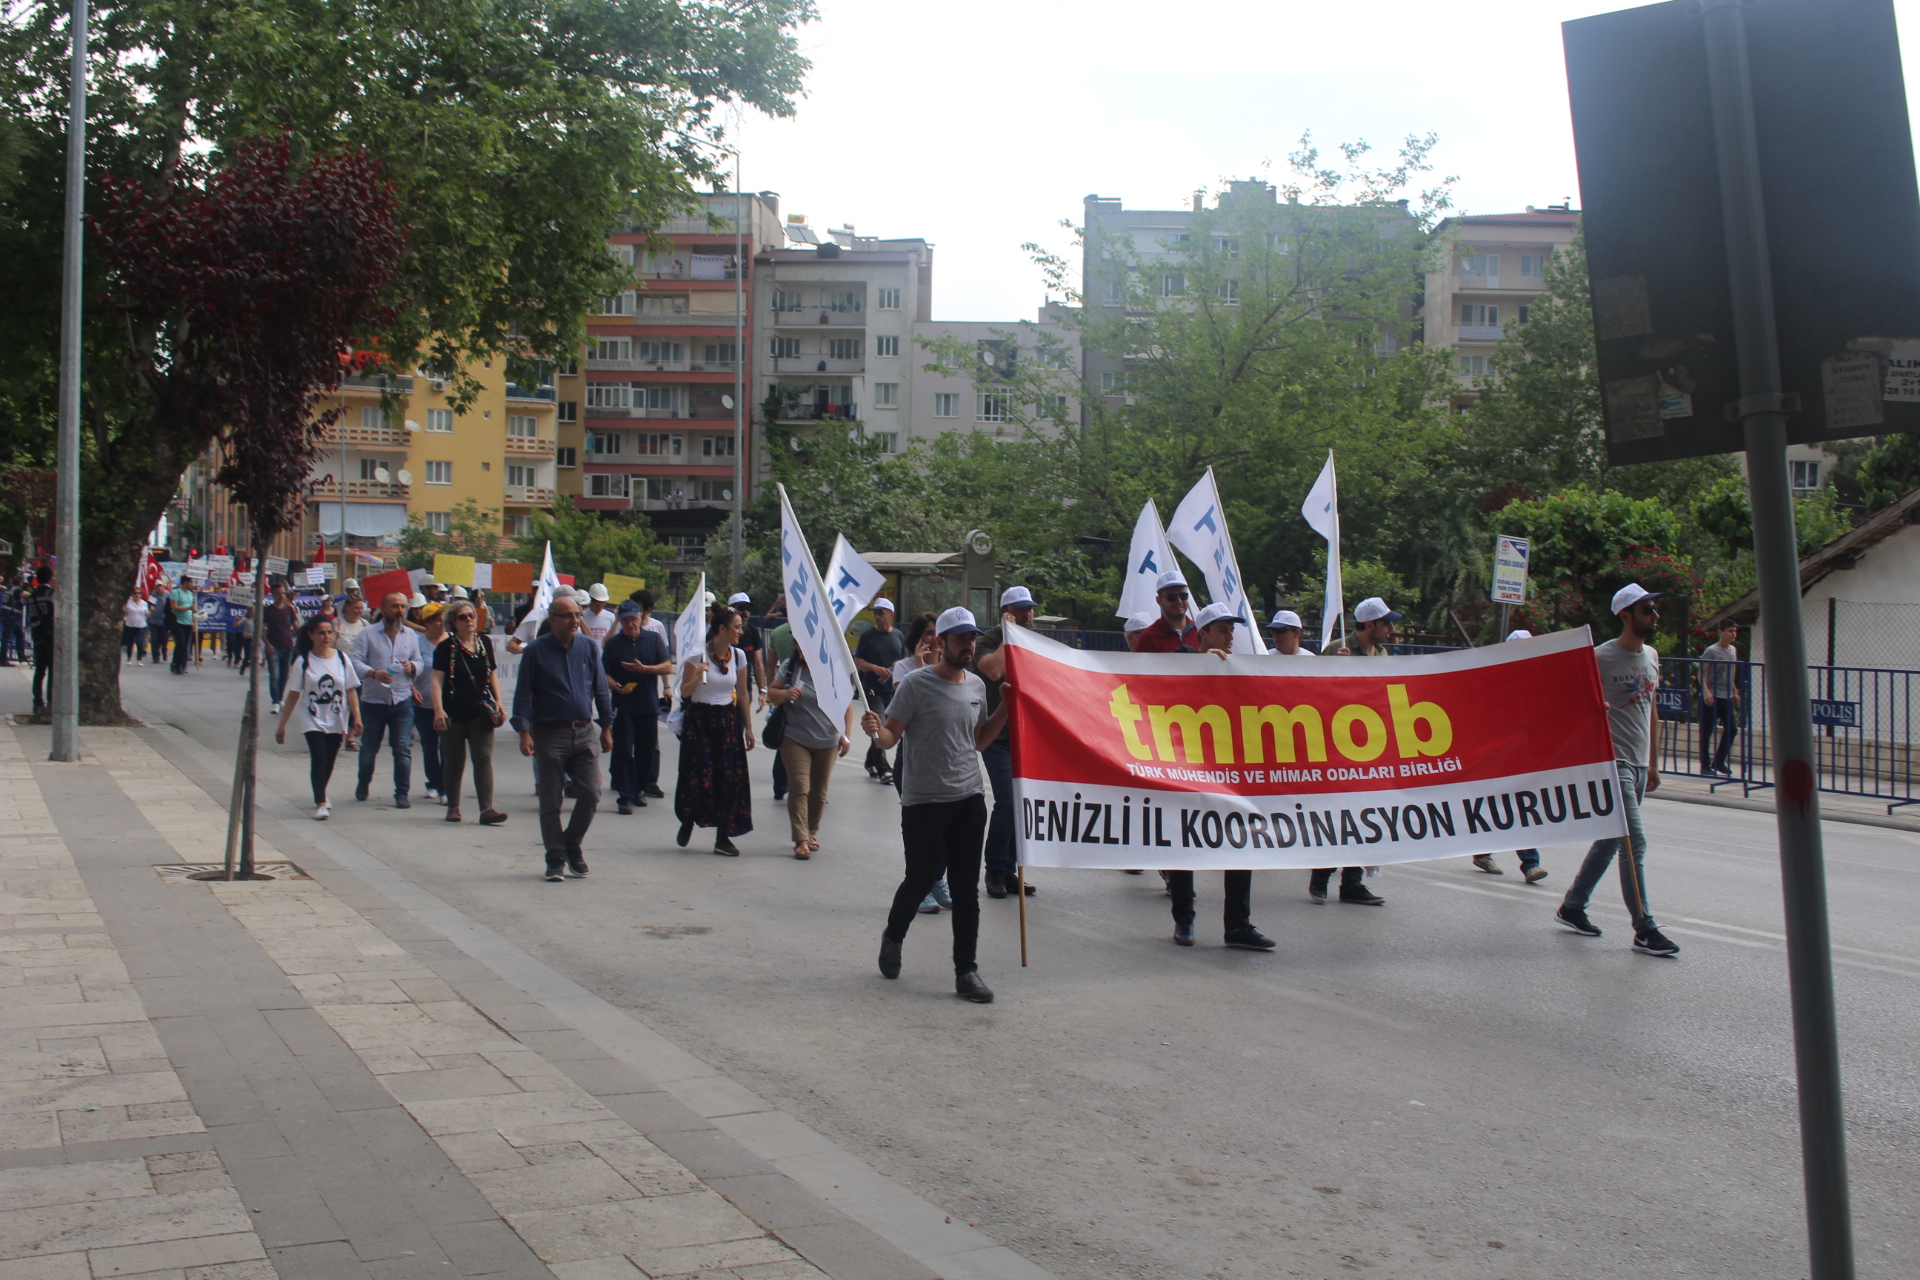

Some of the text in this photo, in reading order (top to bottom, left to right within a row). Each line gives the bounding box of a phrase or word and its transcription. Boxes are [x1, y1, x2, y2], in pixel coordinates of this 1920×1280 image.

[1613, 675, 1635, 683] BORN
[1109, 683, 1453, 764] tmmob
[1126, 756, 1462, 784] TÜRK MÜHENDİS VE MİMAR ODALARI BİRLİĞİ
[1022, 778, 1614, 849] DENİZLİ İL KOORDİNASYON KURULU
